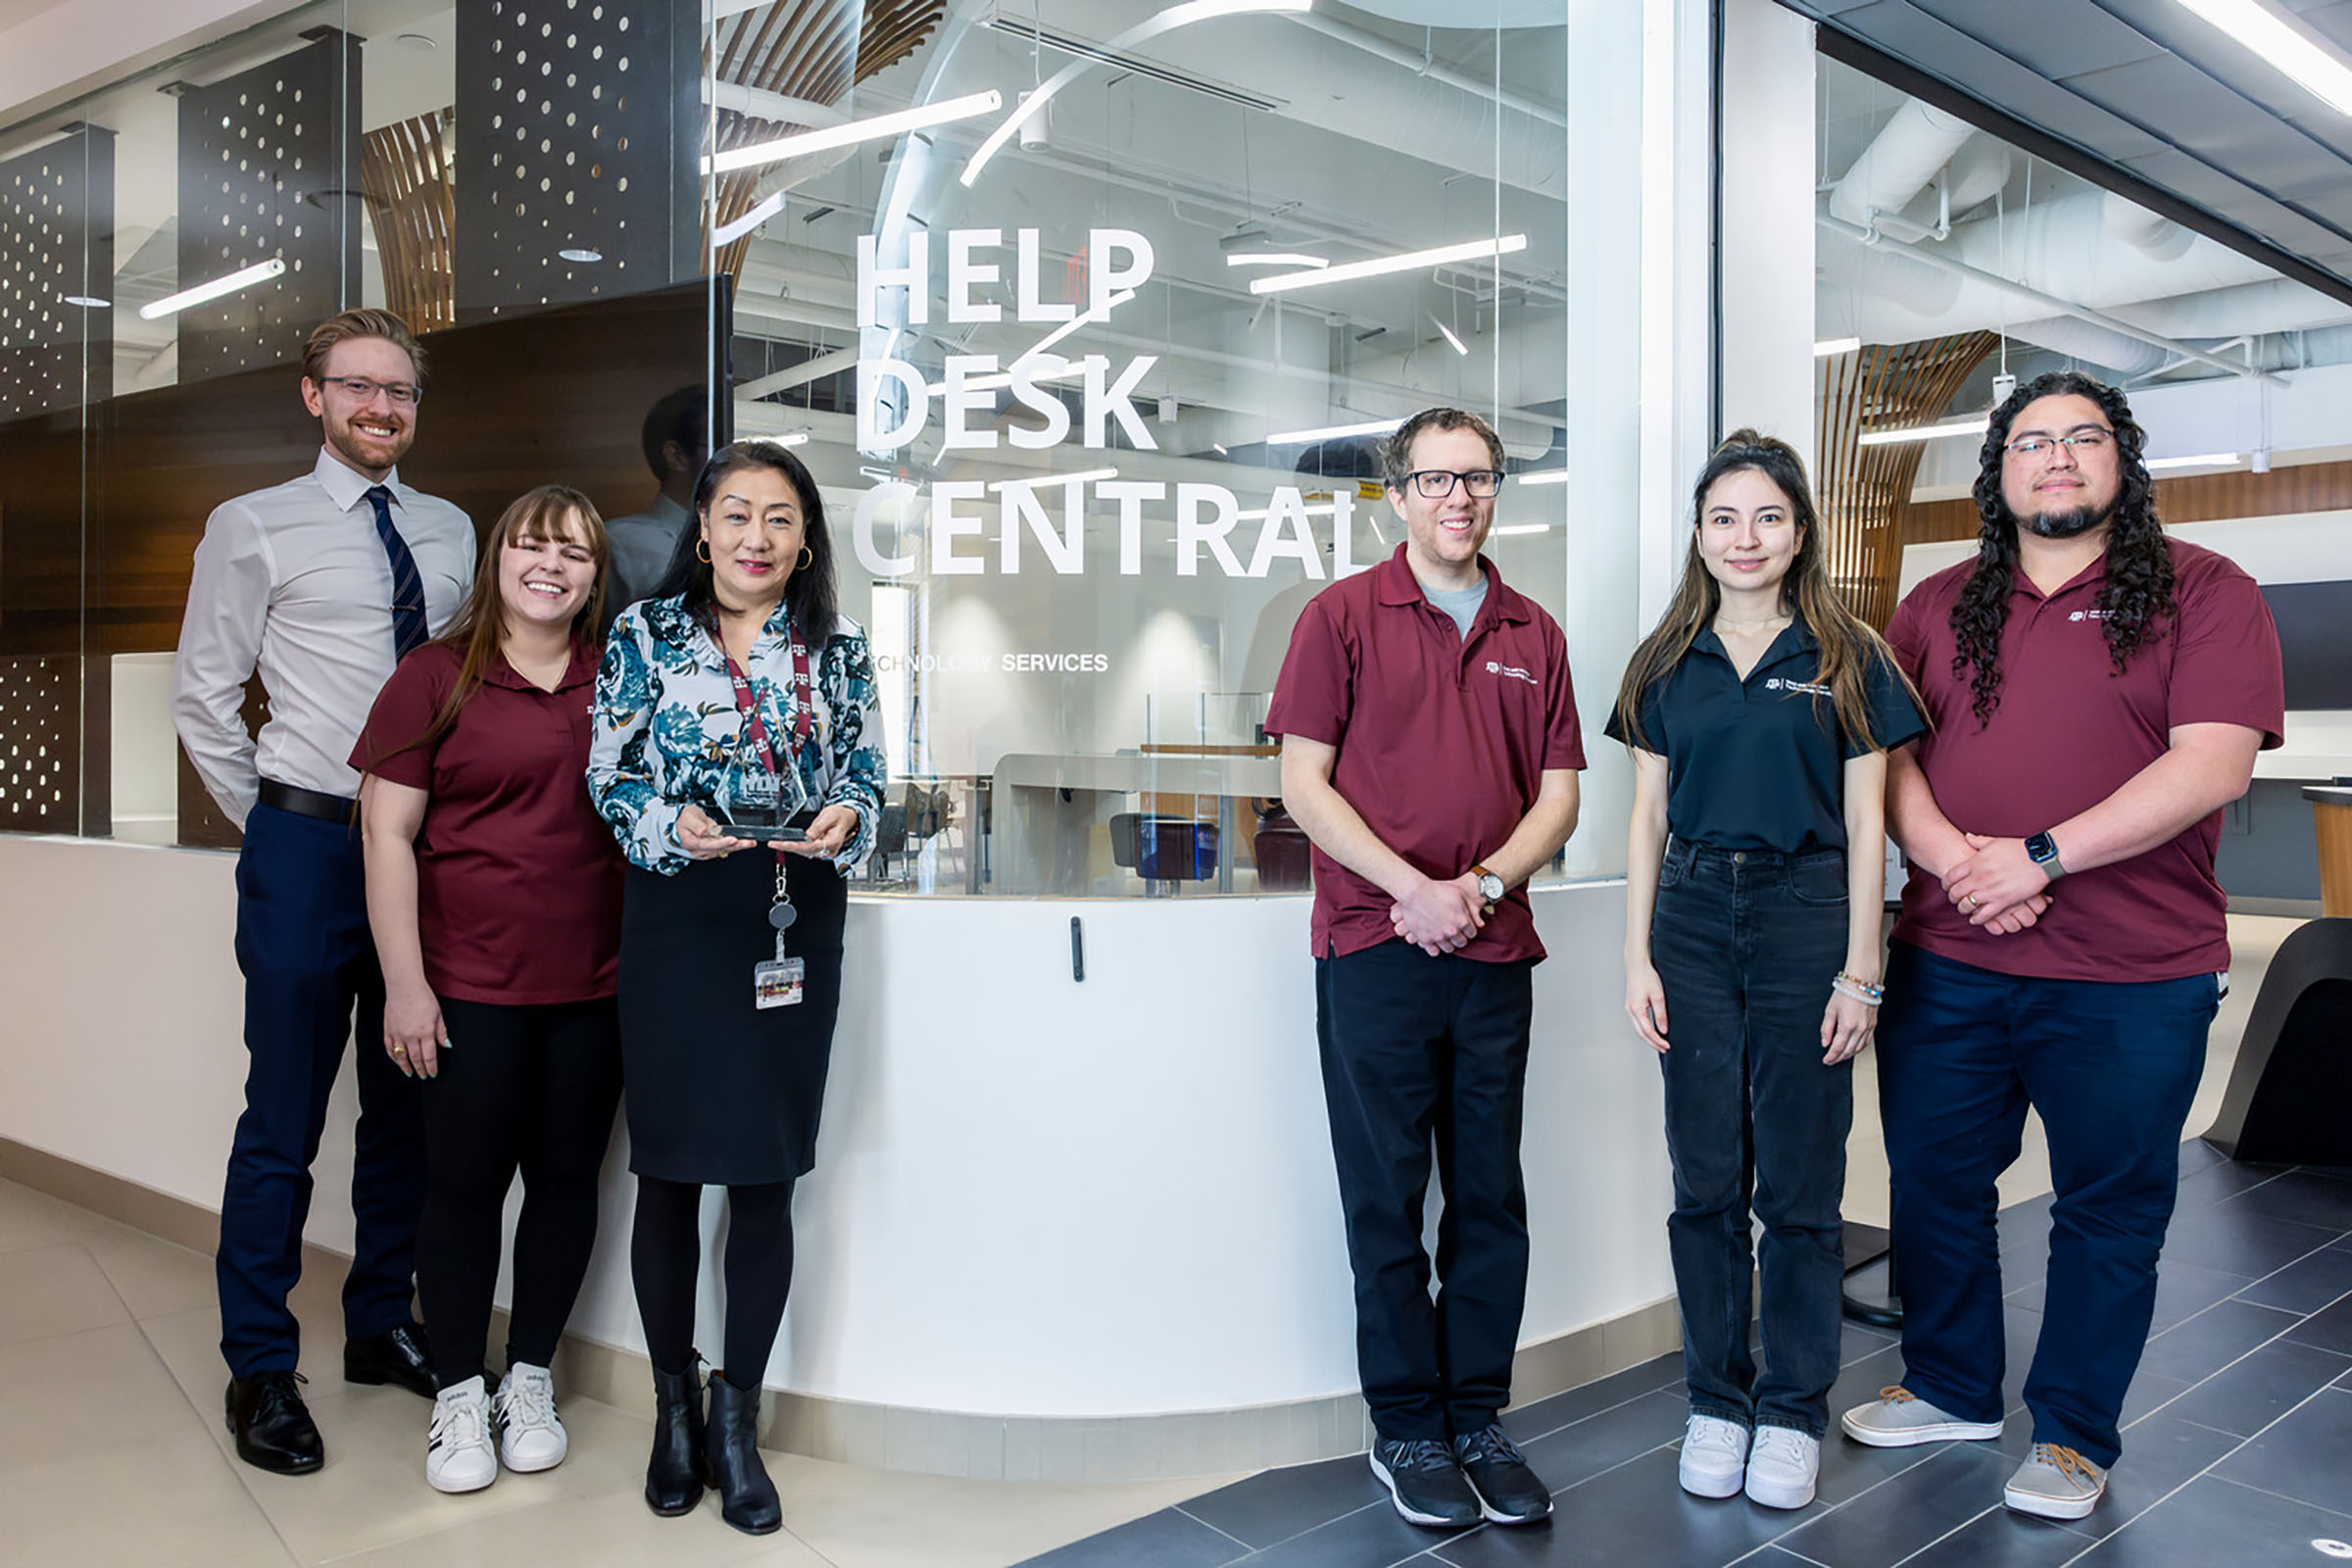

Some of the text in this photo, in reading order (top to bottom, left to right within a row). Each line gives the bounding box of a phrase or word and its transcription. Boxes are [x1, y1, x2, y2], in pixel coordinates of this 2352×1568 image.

[857, 227, 1154, 327] HELP
[857, 354, 1159, 452] DESK
[853, 480, 1373, 580] CENTRAL
[1002, 653, 1109, 673] SERVICES
